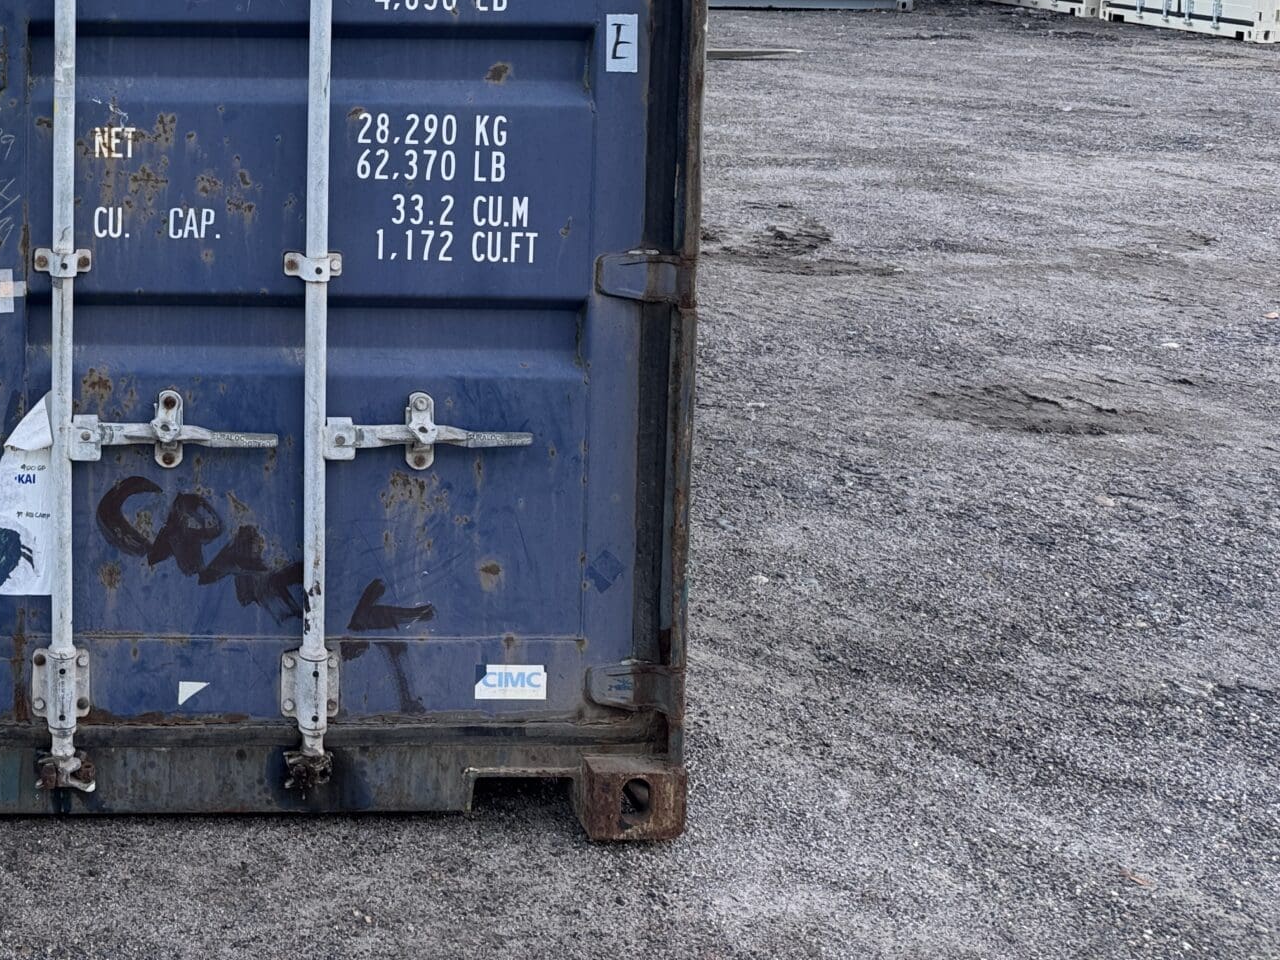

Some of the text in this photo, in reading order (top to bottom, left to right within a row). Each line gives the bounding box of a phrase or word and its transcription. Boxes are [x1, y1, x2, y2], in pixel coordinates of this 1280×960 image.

[94, 127, 136, 158] NET
[357, 113, 508, 147] 28,290 KG
[356, 148, 506, 182] 62,370 LB
[93, 206, 221, 239] CU. CAP.
[391, 193, 529, 228] 33.2 CU.M
[375, 231, 539, 264] 1,172 CU.FT
[481, 671, 542, 688] CIMC
